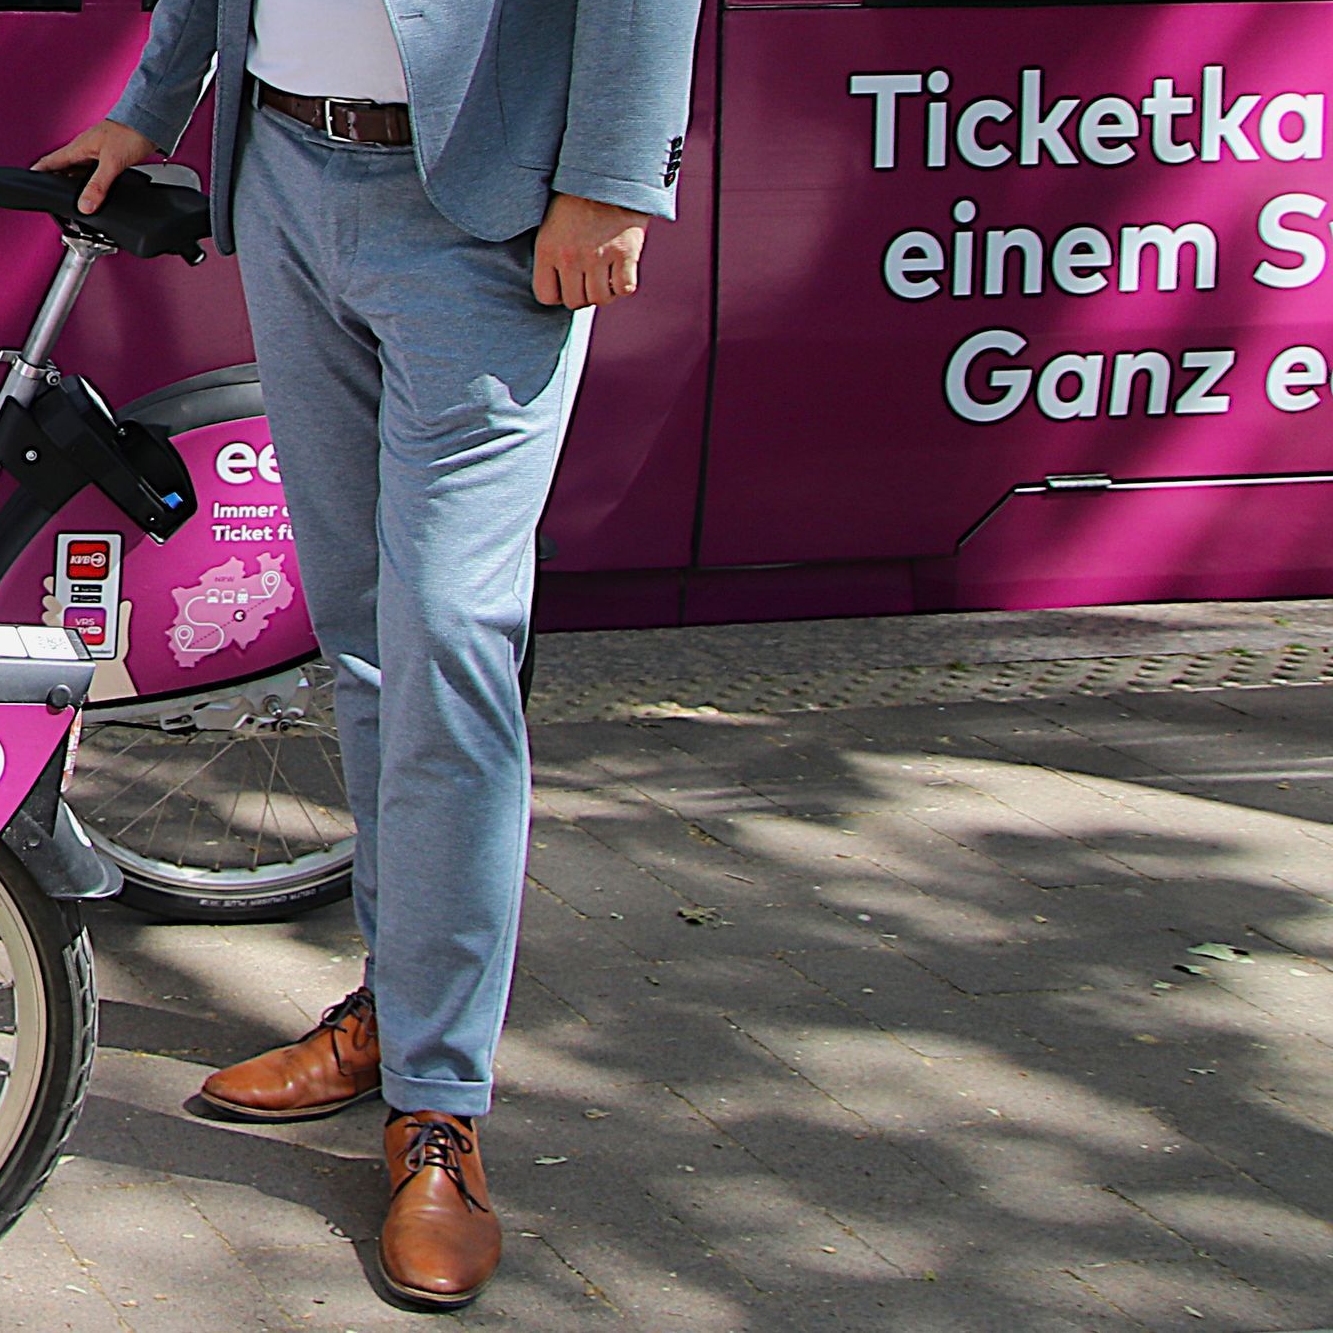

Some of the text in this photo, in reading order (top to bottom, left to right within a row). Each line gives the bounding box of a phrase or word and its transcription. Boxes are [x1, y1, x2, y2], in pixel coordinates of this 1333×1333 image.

[883, 192, 1333, 300] einem S
[944, 328, 1333, 424] Ganz e
[211, 524, 274, 542] Ticket
[212, 502, 279, 519] Immer
